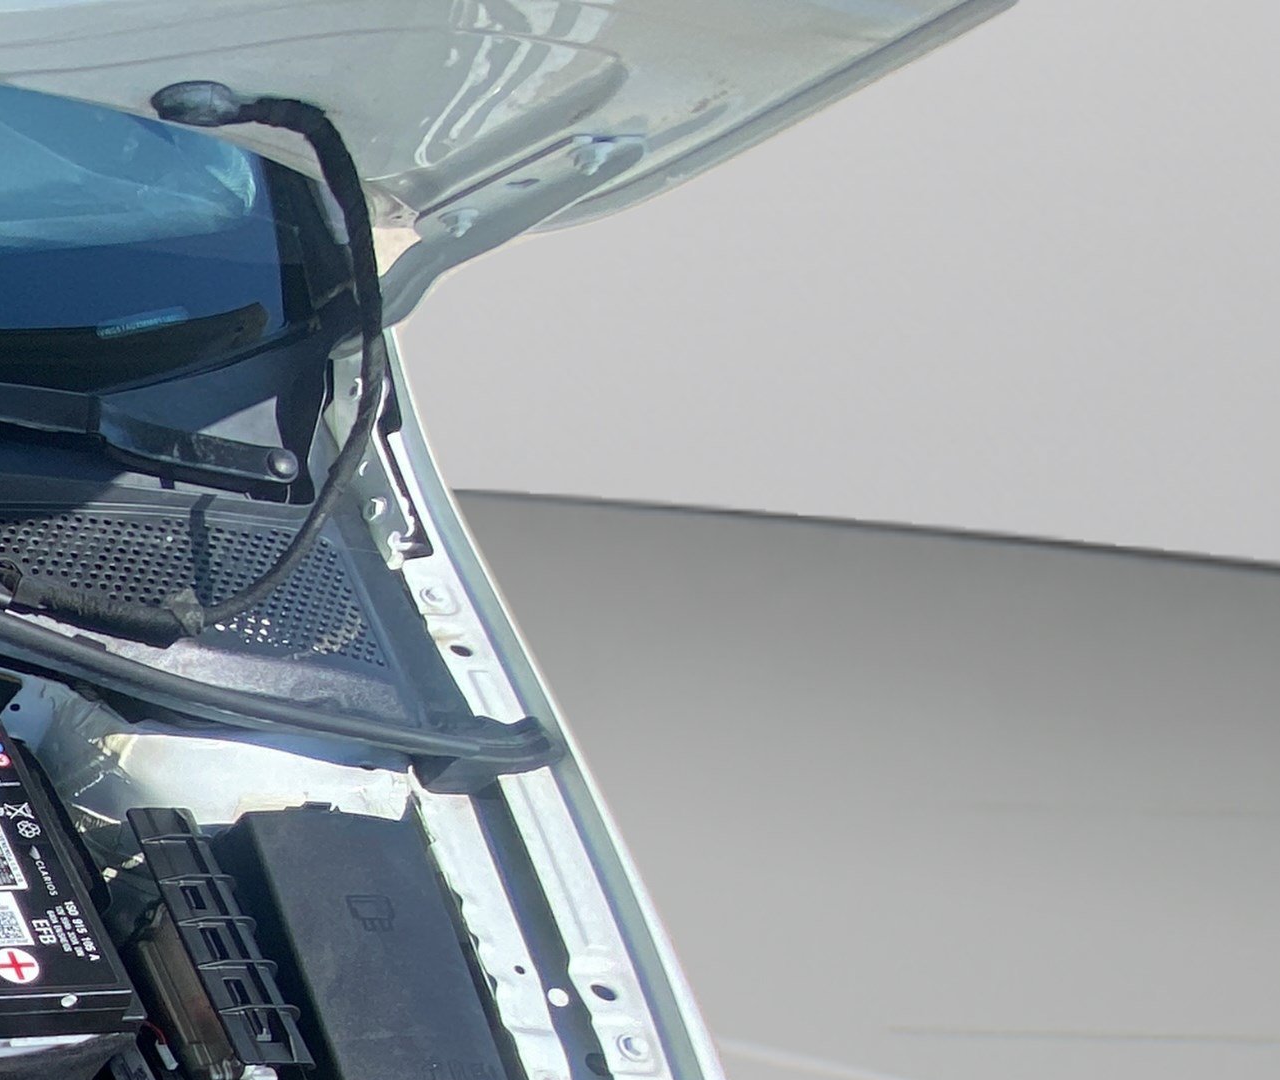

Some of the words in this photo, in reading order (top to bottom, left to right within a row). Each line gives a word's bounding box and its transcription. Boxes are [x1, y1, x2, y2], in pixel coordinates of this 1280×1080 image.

[36, 860, 58, 896] CLARIOS
[32, 920, 57, 944] EFB
[72, 919, 87, 933] 915
